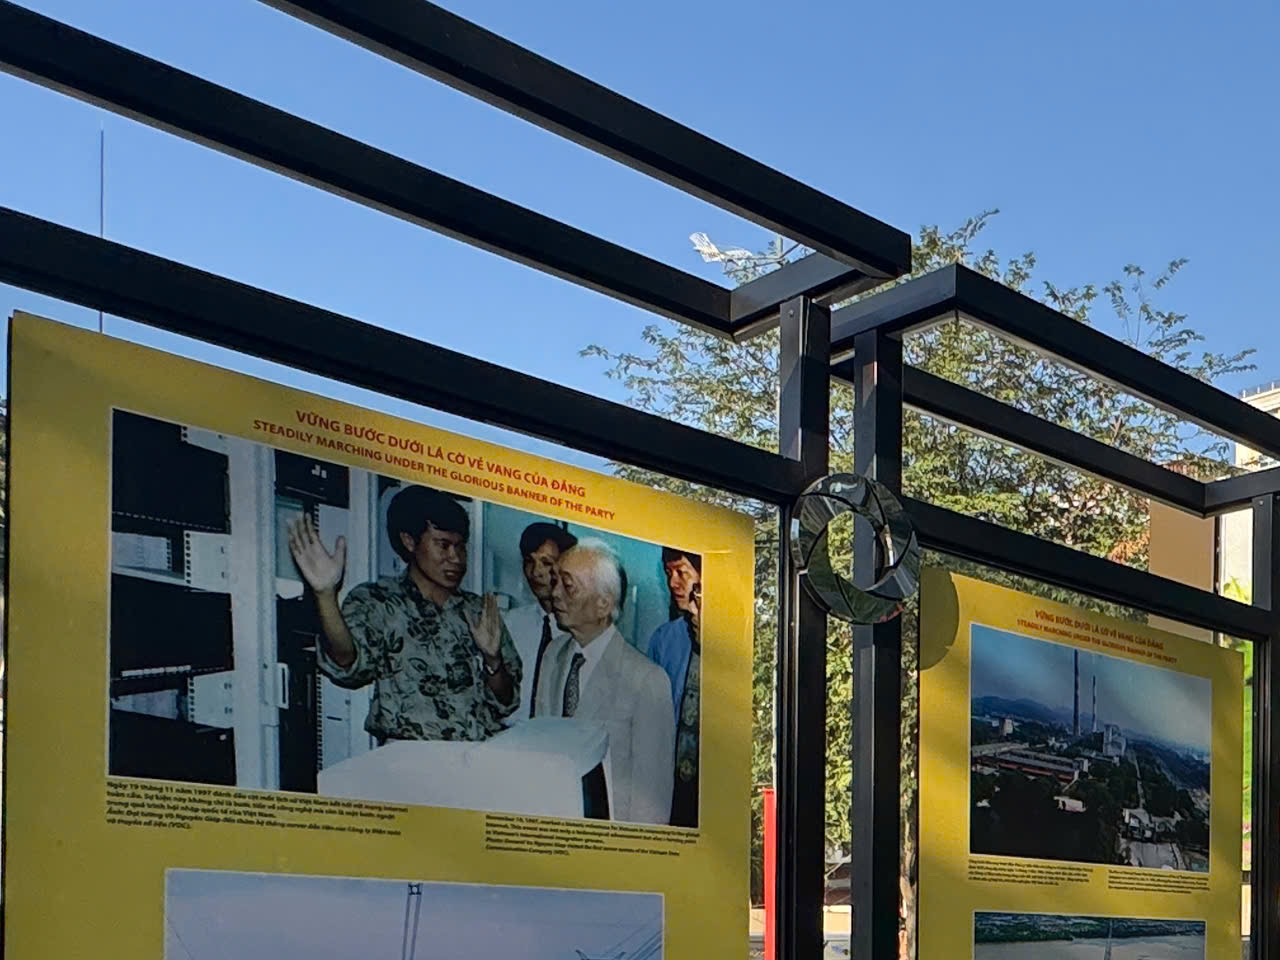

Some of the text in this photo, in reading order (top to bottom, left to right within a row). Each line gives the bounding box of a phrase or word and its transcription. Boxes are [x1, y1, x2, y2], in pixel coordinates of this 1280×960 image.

[254, 420, 615, 520] STEADILY MARCHING UNDER THE GLORIOUS BANNER OF THE PARTY
[296, 410, 340, 432] VỮNG
[344, 423, 386, 445] BƯỚC
[388, 435, 424, 455] DƯỚI
[428, 444, 444, 460] LÁ
[447, 450, 466, 466] CỜ
[486, 461, 521, 481] VANG
[524, 472, 549, 488] CỦA
